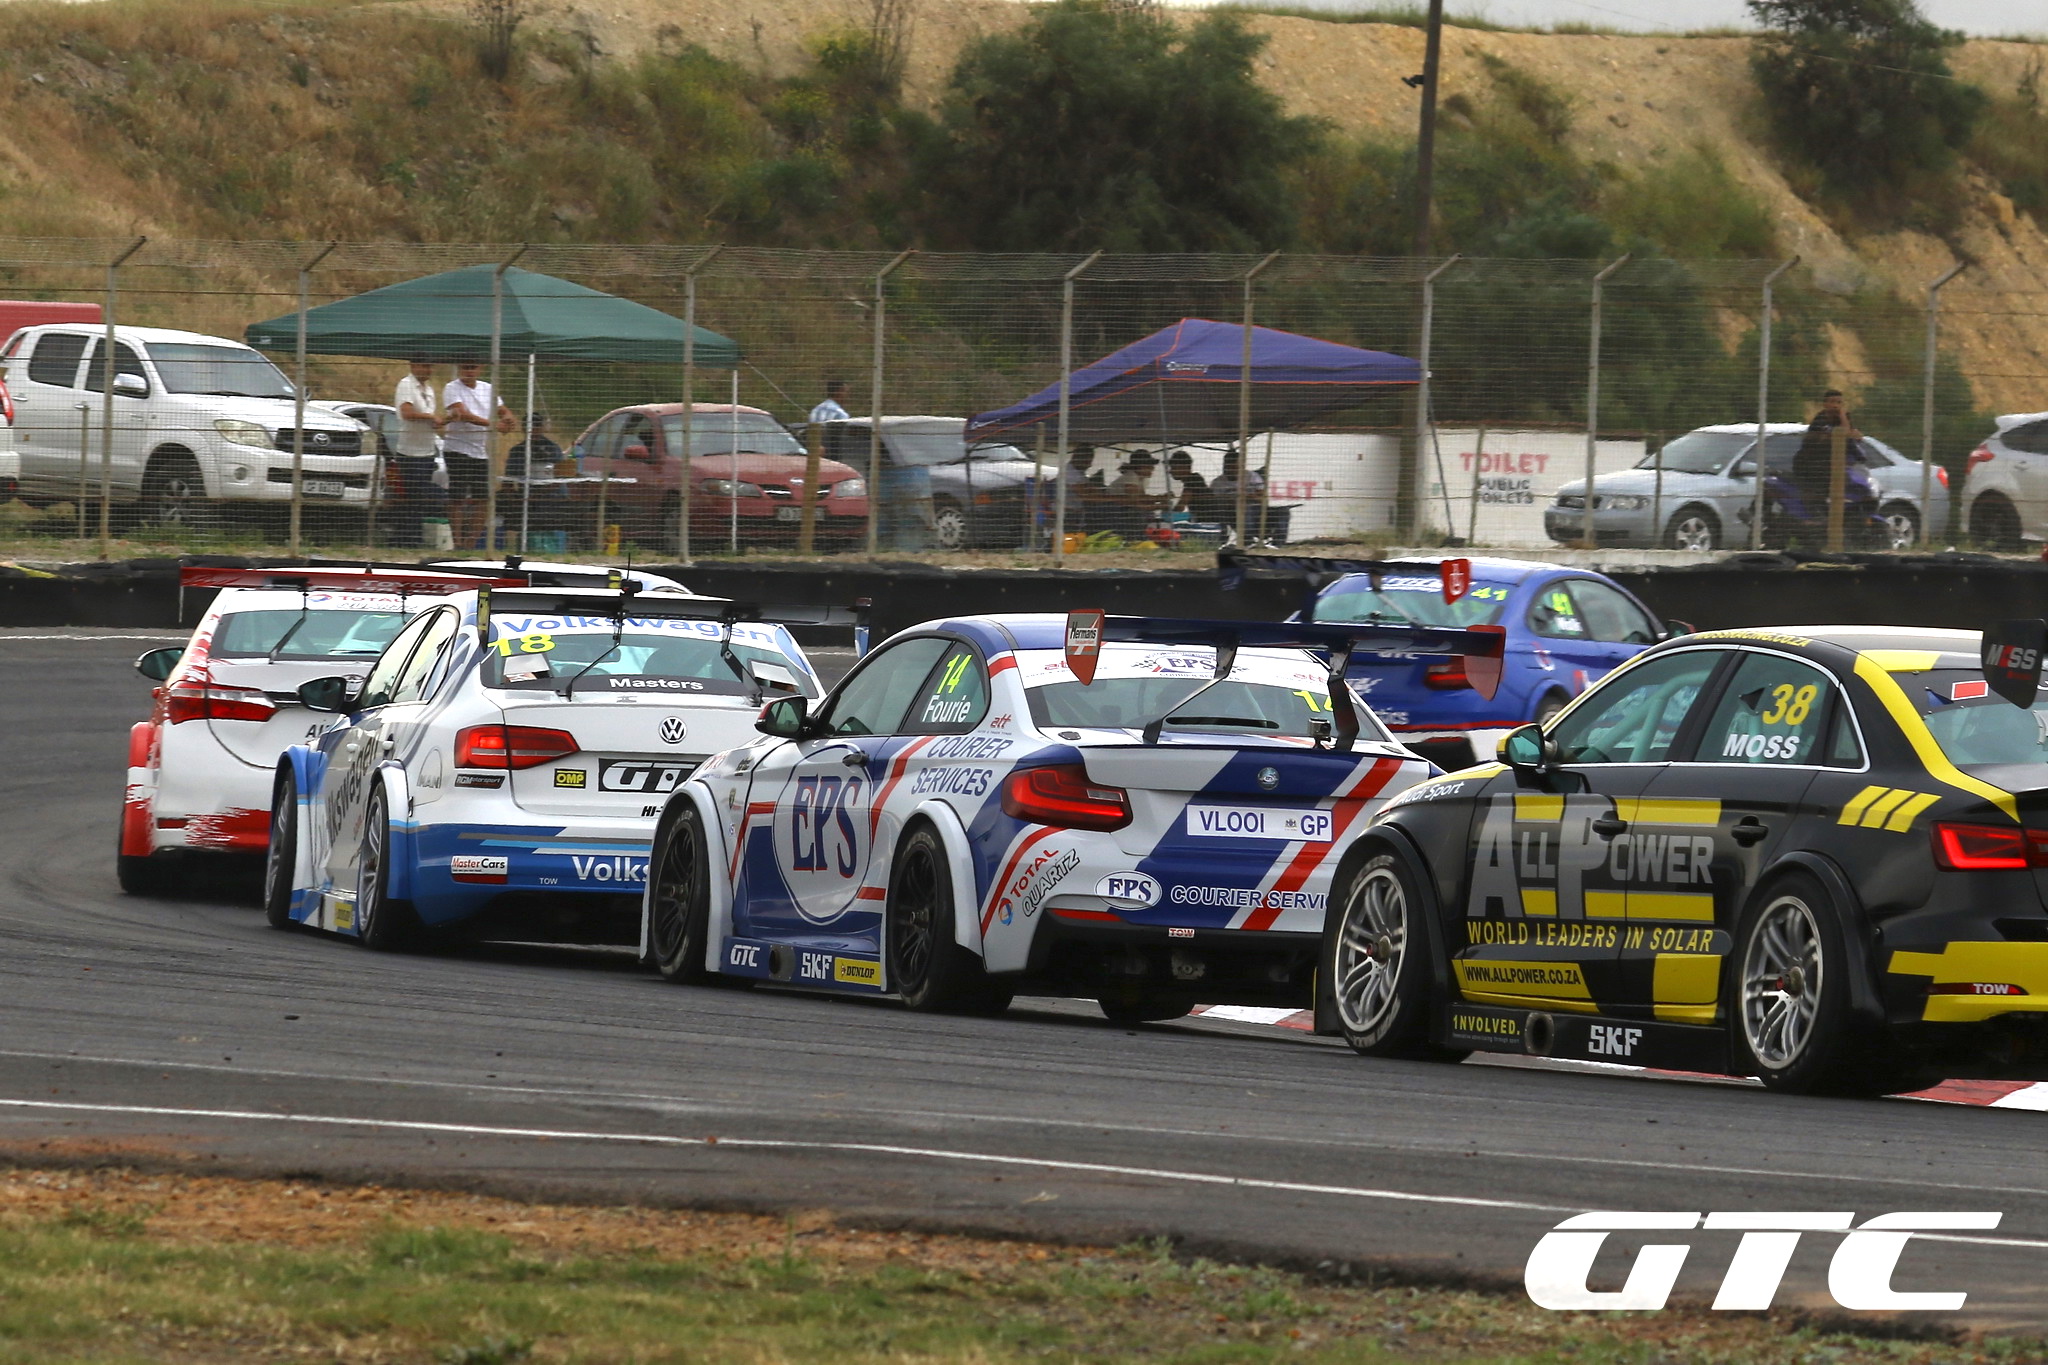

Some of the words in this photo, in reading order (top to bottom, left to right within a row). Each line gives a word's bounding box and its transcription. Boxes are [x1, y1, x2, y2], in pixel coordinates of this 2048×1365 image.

[1459, 452, 1550, 474] TOILET
[1269, 480, 1318, 501] LET
[360, 580, 460, 590] TOYOTA
[1471, 587, 1508, 601] 41
[503, 615, 773, 644] Volkswagen
[1070, 621, 1098, 640] Hermans
[488, 633, 557, 657] 18
[936, 654, 974, 694] 14
[1167, 657, 1217, 671] EPS
[609, 677, 704, 691] Masters
[921, 694, 972, 723] Fourie
[1763, 683, 1818, 726] 38
[927, 736, 1014, 760] COURIER
[1723, 733, 1801, 760] MOSS
[556, 774, 585, 785] OMP
[602, 761, 697, 791] GT
[911, 767, 993, 797] SERVICES
[1425, 781, 1465, 802] Sport
[792, 773, 864, 879] EPS
[1199, 810, 1265, 833] VLOOI
[1300, 815, 1329, 836] GP
[538, 877, 558, 885] TOW
[1010, 849, 1059, 899] TOTAL
[1021, 848, 1081, 917] QUARTZ
[1108, 878, 1152, 902] EPS
[1171, 885, 1264, 909] COURIER
[1266, 890, 1329, 911] SERVI
[1169, 928, 1195, 937] TOW
[1466, 921, 1529, 945] WORLD
[1536, 924, 1618, 949] LEADERS
[1624, 927, 1644, 950] IN
[1649, 928, 1714, 953] SOLAR
[729, 944, 761, 968] GTC
[801, 952, 833, 980] SKF
[846, 965, 875, 979] DUNLOP
[1465, 965, 1582, 986] WWW.ALLPOWER.CO.ZA
[1973, 983, 2009, 995] TOW
[1588, 1025, 1643, 1057] SKF
